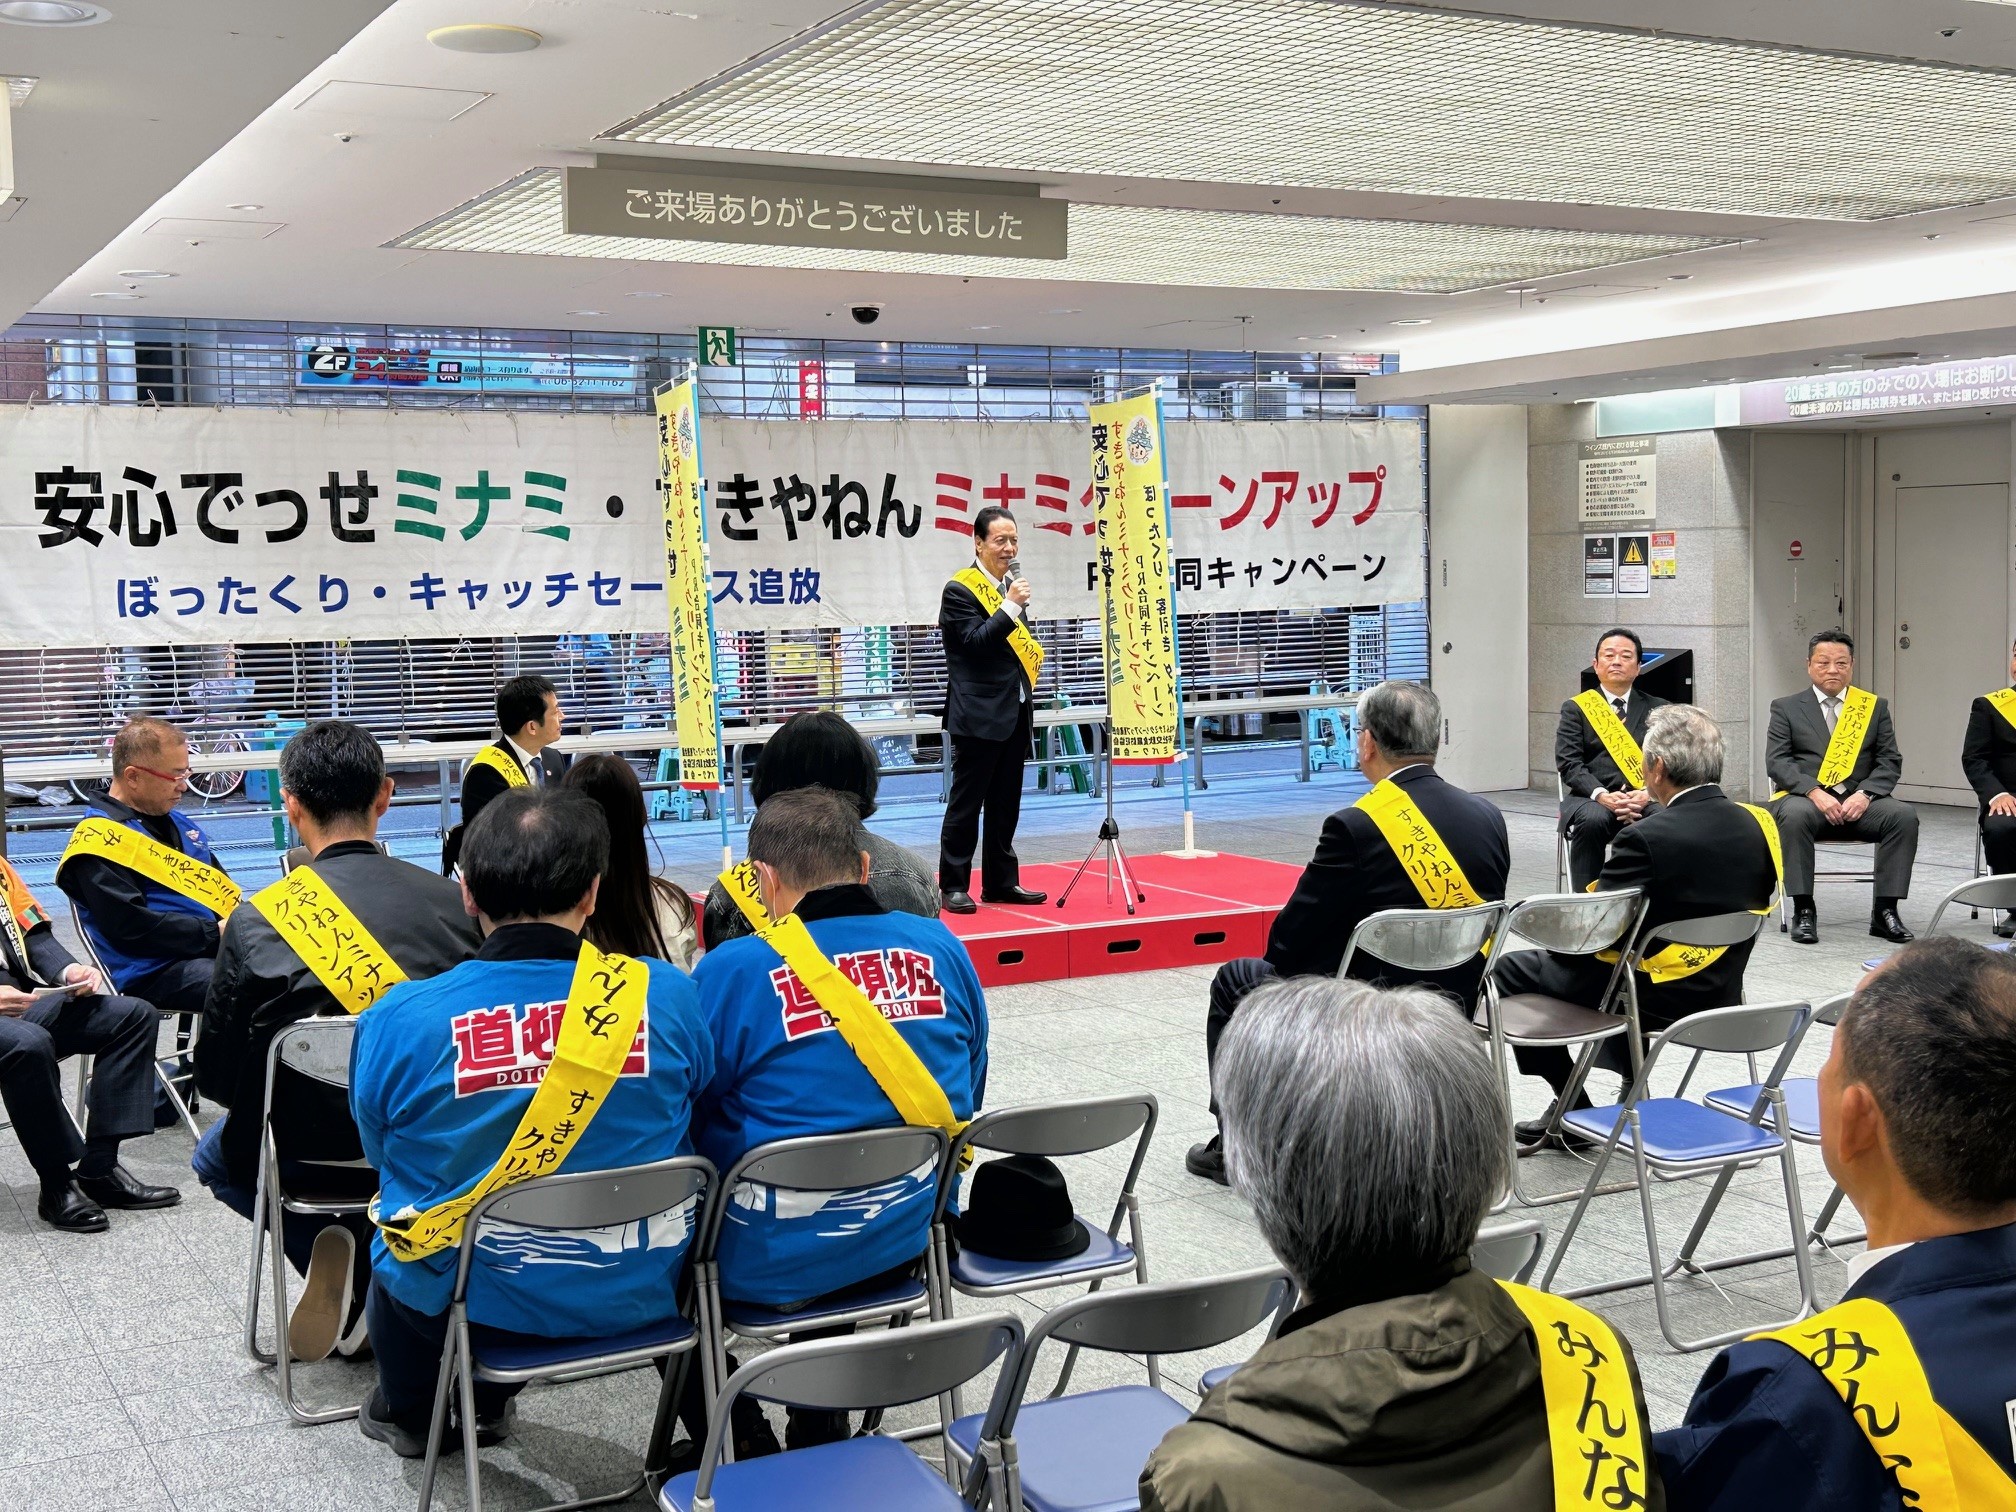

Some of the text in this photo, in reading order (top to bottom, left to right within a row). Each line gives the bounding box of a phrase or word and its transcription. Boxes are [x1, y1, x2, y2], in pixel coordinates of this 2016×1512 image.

[624, 188, 1023, 241] ご来場ありがとうございました
[313, 346, 348, 370] 2F
[117, 568, 822, 618] ぼったくり・キャッチセース追放
[1087, 552, 1388, 592] 同キャンペーン
[1396, 808, 1475, 907] すきやねんミ
[1402, 843, 1447, 909] クリーン
[285, 877, 395, 990] きやねんミナ
[820, 1001, 919, 1028] DBORI
[496, 1067, 547, 1085] DOTO
[1550, 1320, 1646, 1511] みんな
